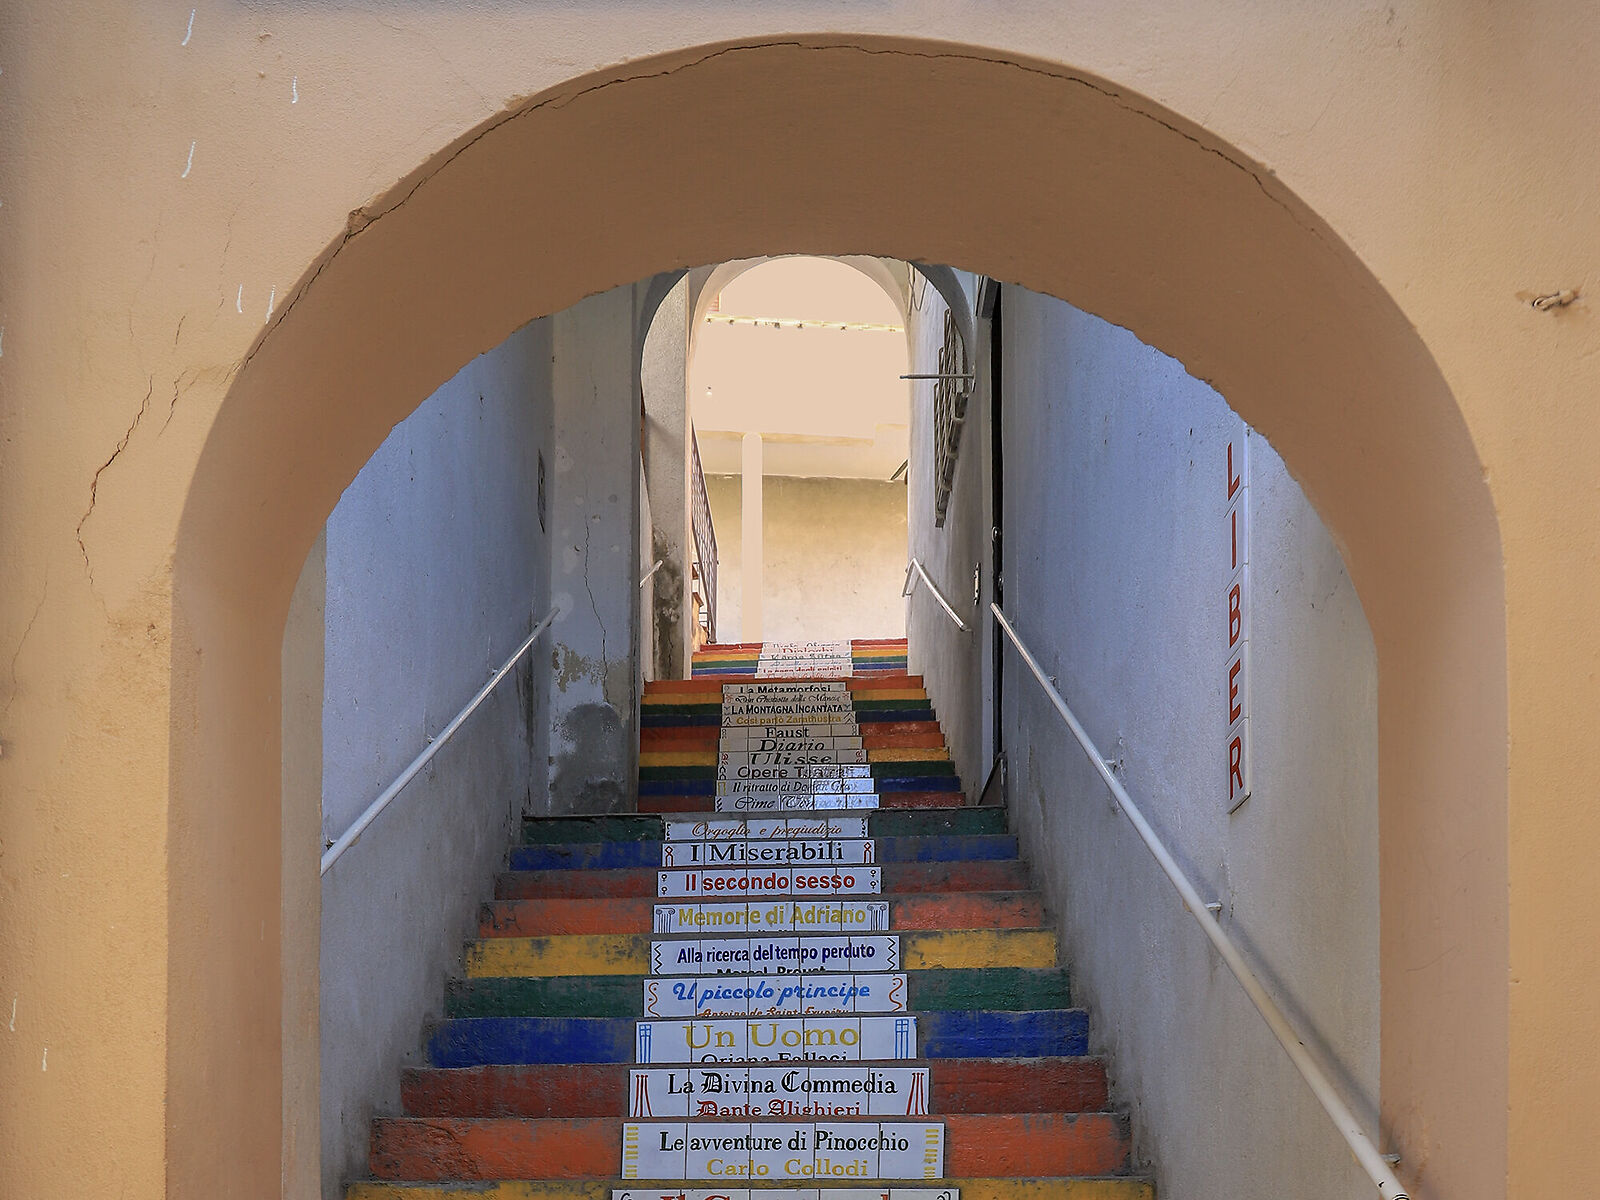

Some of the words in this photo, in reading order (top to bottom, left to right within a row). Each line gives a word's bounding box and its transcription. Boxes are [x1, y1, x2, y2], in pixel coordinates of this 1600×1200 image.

[1226, 441, 1244, 800] LIBER
[746, 704, 793, 714] MONTAGNA
[795, 703, 843, 713] INCANTATA
[765, 727, 809, 738] Faust
[757, 739, 825, 751] Diario
[750, 752, 832, 765] Ulisse
[737, 766, 788, 780] Opere
[743, 782, 778, 793] ritratto
[781, 781, 790, 792] di
[691, 822, 751, 840] Orgoglio
[759, 826, 767, 835] e
[770, 822, 843, 840] pregiudizio
[690, 844, 700, 862] I
[708, 842, 844, 862] Miserabili
[685, 873, 697, 891] Il
[703, 873, 790, 891] secondo
[796, 874, 856, 890] sesso
[678, 907, 761, 926] Memorie
[765, 905, 784, 925] di
[788, 904, 867, 925] Adriano
[677, 947, 702, 964] Alla
[706, 946, 750, 963] ricerca
[753, 944, 773, 961] del
[775, 945, 818, 964] tempo
[822, 942, 876, 963] perduto
[697, 980, 774, 1008] piccolo
[776, 981, 871, 1007] principe
[682, 1024, 736, 1049] Un
[748, 1022, 860, 1048] Uomo
[667, 1072, 696, 1095] La
[699, 1071, 776, 1095] Divina
[780, 1070, 899, 1095] Commedia
[696, 1099, 762, 1117] Dante
[767, 1098, 862, 1116] Alighieri
[659, 1131, 684, 1151] Le
[690, 1135, 783, 1151] avventure
[786, 1130, 808, 1151] di
[814, 1130, 909, 1151] Pinocchio
[706, 1158, 770, 1177] Carlo
[783, 1158, 869, 1177] Collodi
